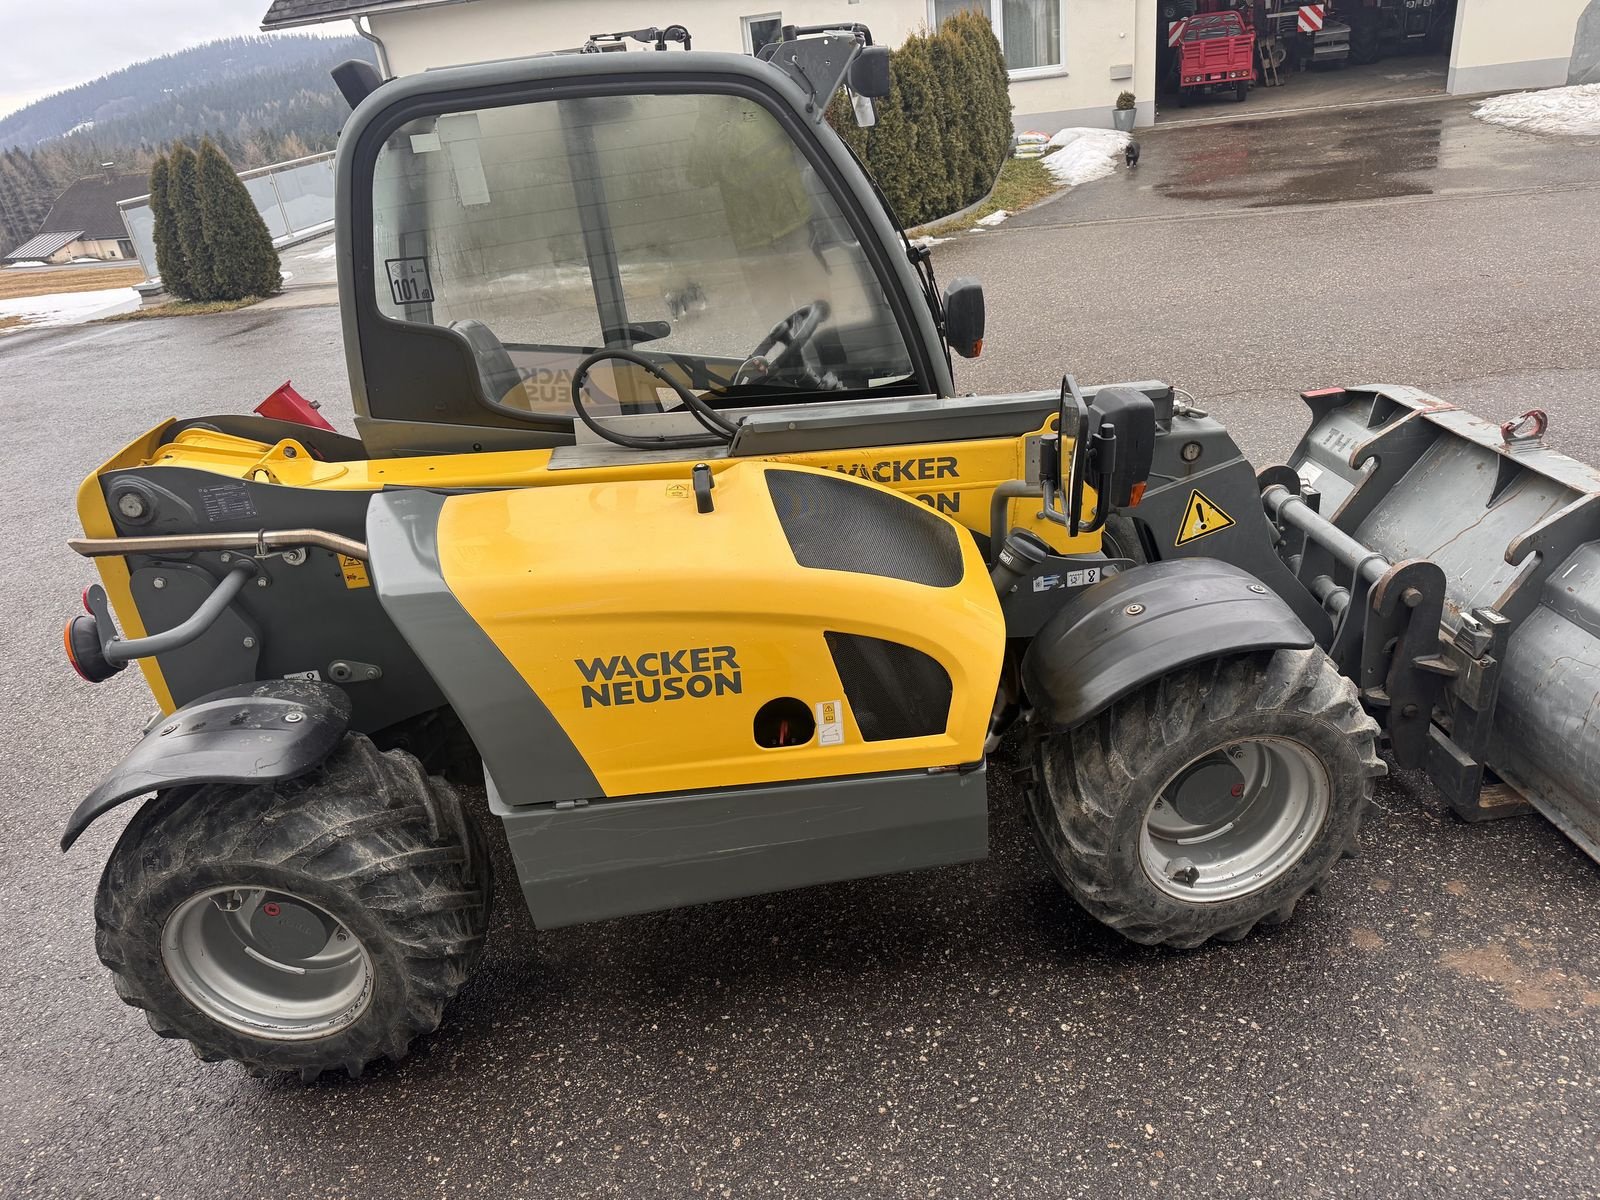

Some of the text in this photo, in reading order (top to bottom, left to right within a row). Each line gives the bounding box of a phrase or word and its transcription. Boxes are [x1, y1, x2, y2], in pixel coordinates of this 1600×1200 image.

[394, 278, 420, 301] 101
[574, 645, 741, 682] WACKER
[581, 671, 743, 708] NEUSON
